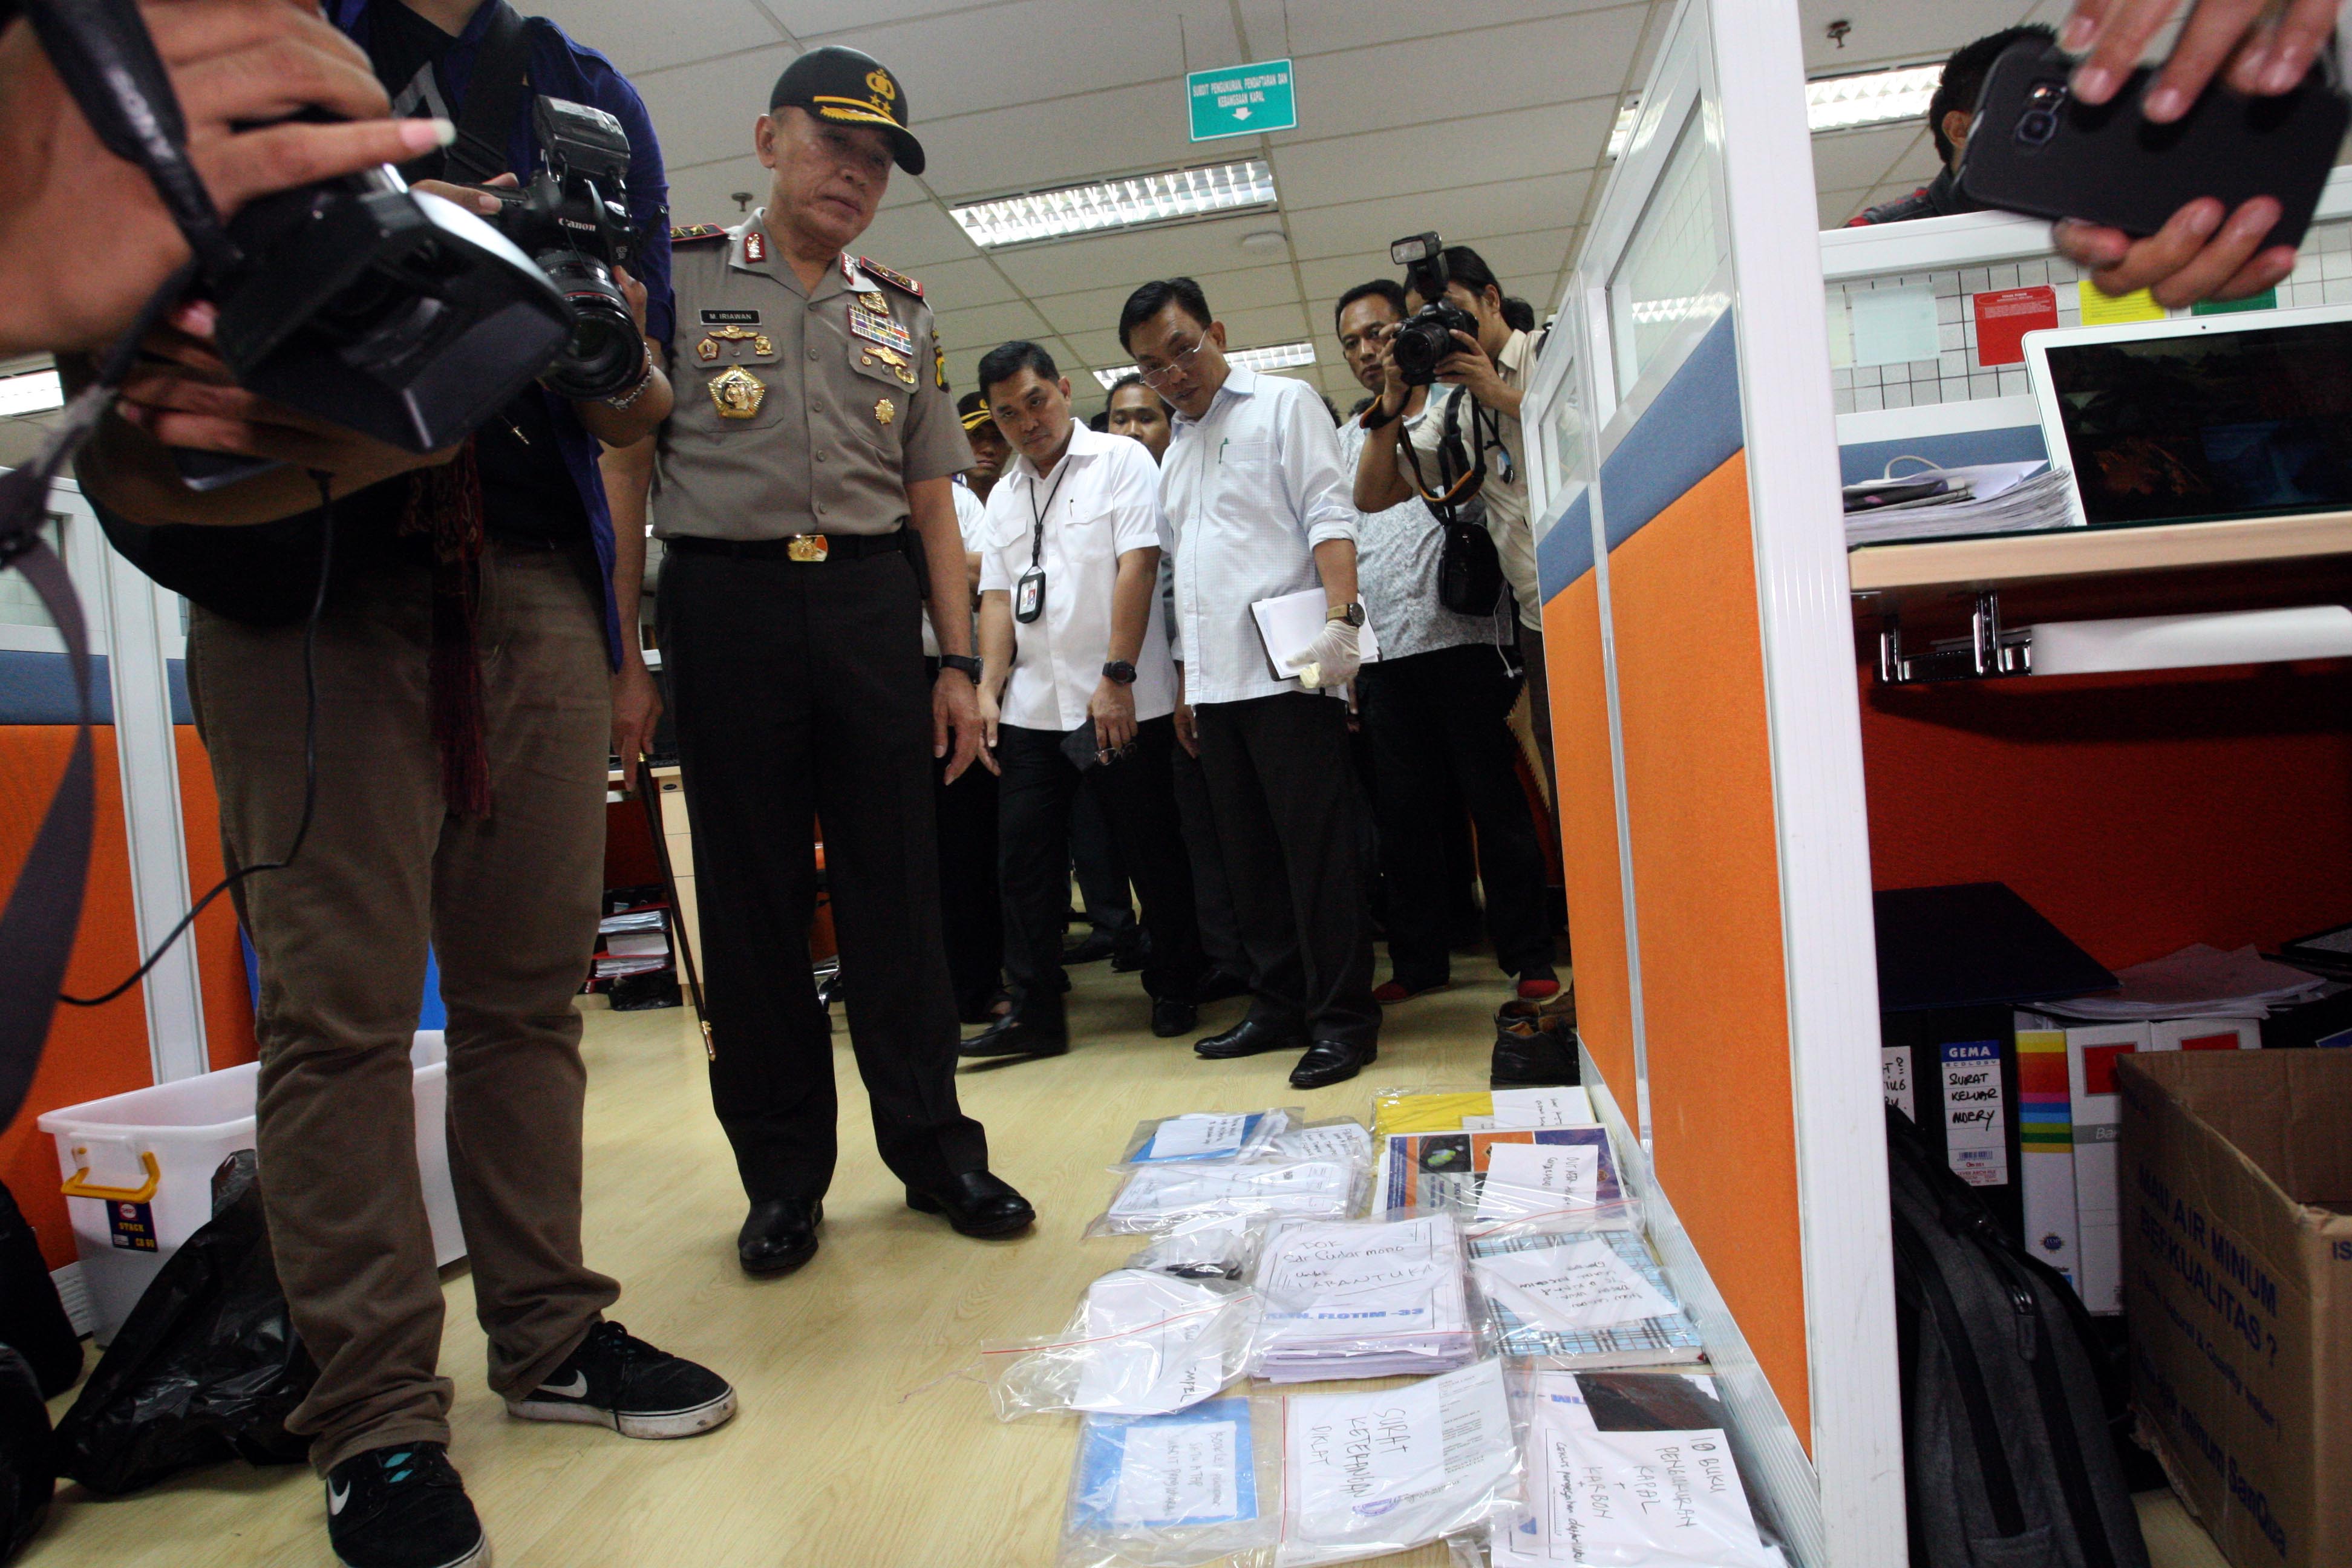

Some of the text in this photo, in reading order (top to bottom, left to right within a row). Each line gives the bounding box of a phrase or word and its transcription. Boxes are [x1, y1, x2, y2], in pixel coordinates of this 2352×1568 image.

[558, 217, 596, 232] Canon
[1949, 1047, 1991, 1057] GEMA
[1949, 1073, 1988, 1085] SURAT
[1952, 1088, 1999, 1101] KELUAR
[2174, 1198, 2206, 1249] AIR
[2212, 1227, 2275, 1317] MINUM
[1318, 1311, 1387, 1319] FLOTIM
[1308, 1426, 1332, 1465] DIKLAT
[1373, 1408, 1411, 1454] SURAT
[1582, 1466, 1614, 1519] KARBON
[1633, 1465, 1660, 1515] KAPAL
[1699, 1458, 1726, 1493] BUKU
